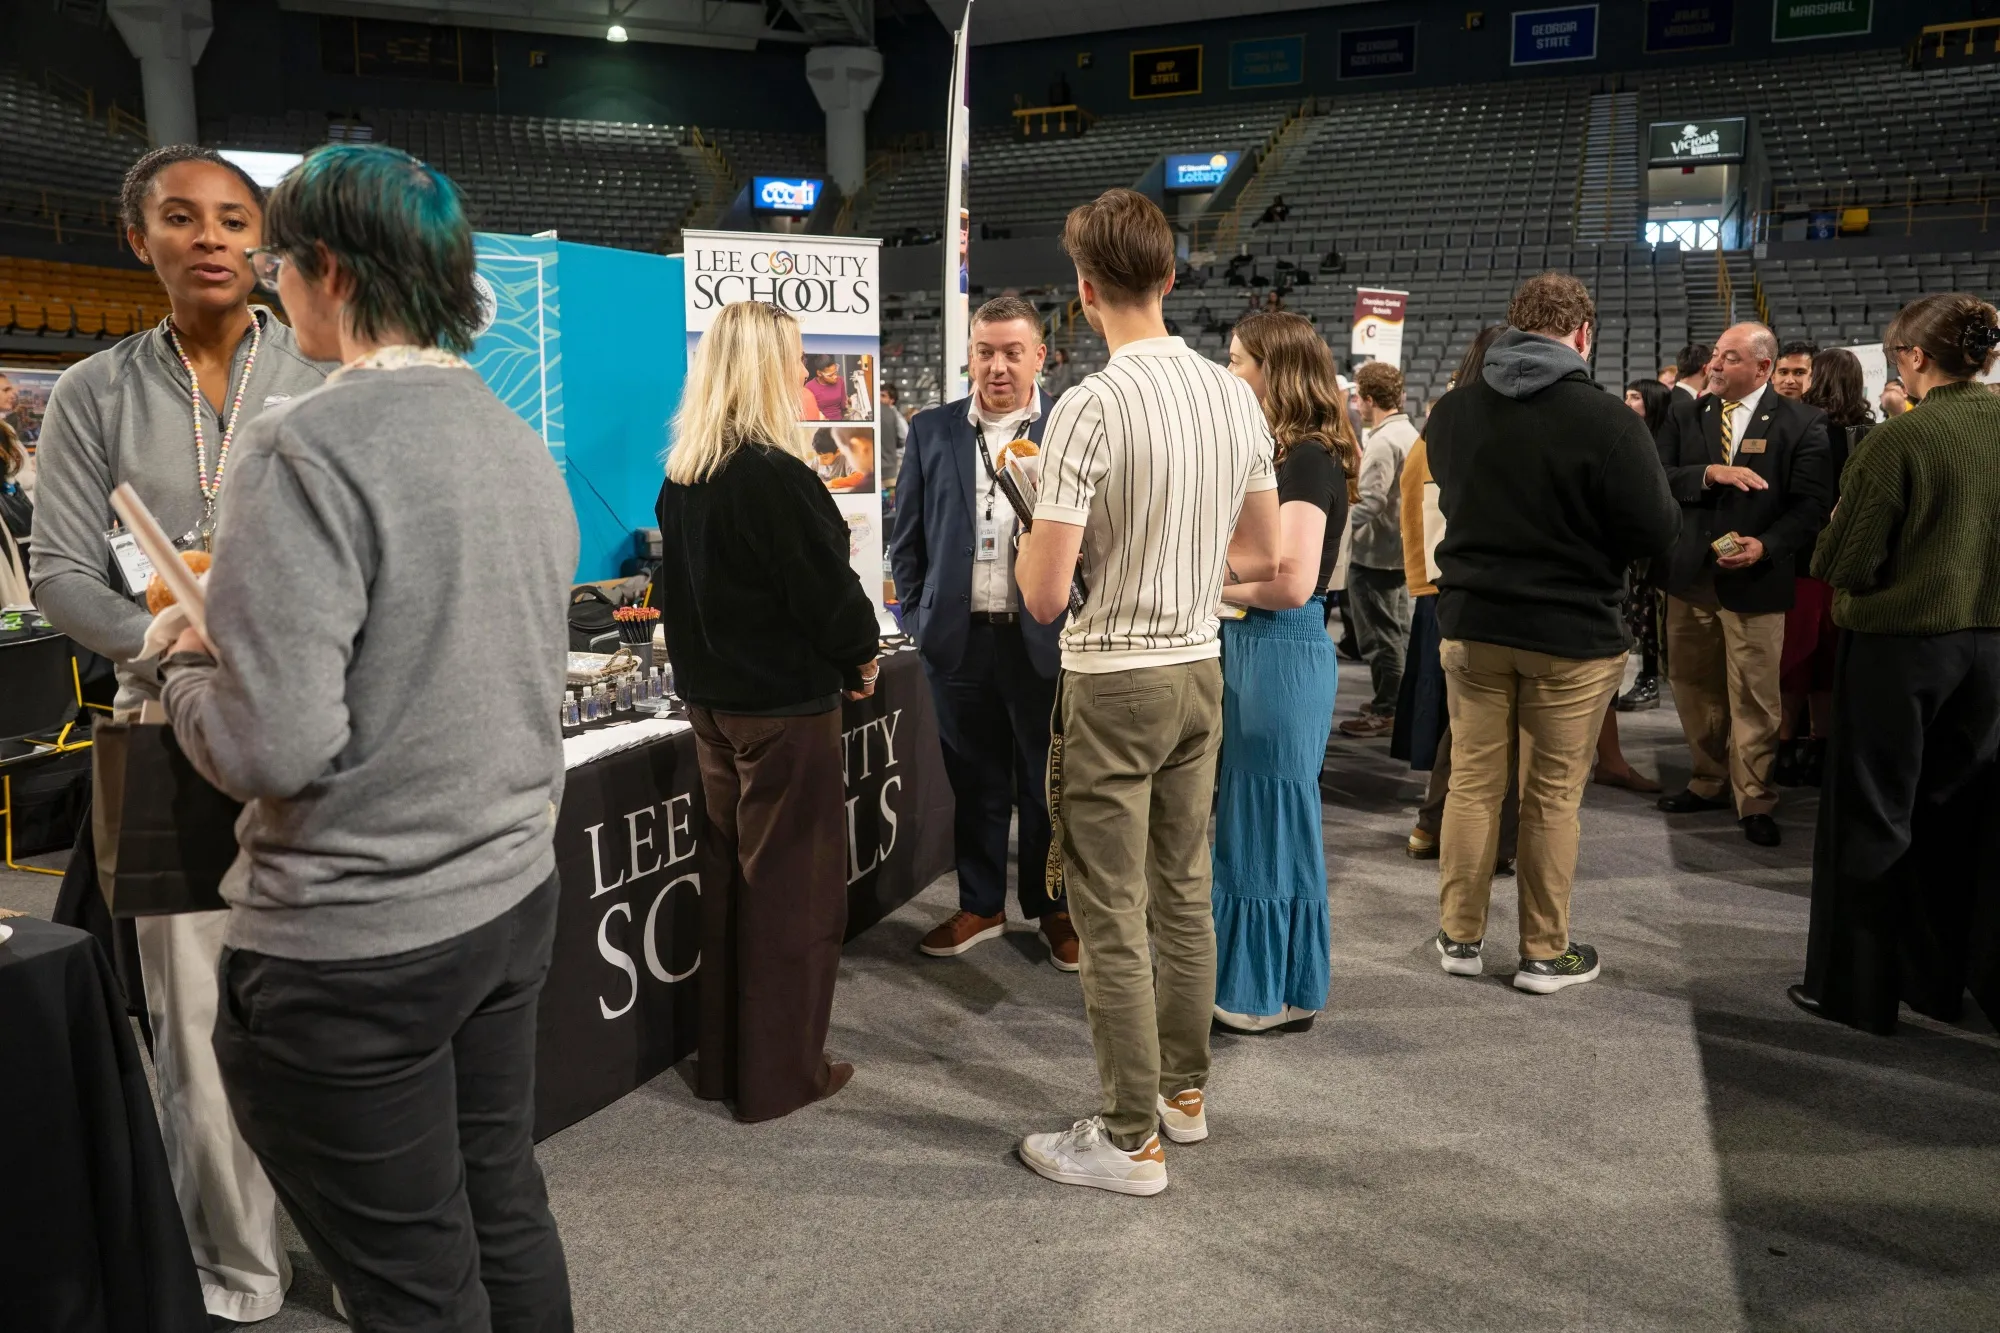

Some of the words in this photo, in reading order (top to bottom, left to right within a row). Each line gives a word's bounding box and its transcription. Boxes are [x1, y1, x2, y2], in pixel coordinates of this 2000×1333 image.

[1789, 0, 1856, 19] MARSHALL
[1531, 20, 1578, 36] GEORGIA
[1536, 35, 1572, 50] STATE
[1150, 72, 1180, 85] STATE
[1179, 170, 1227, 184] Lottery
[694, 250, 744, 273] LEE
[750, 250, 868, 278] COUNTY
[693, 274, 870, 315] SCHOOLS
[584, 792, 697, 899] LEE
